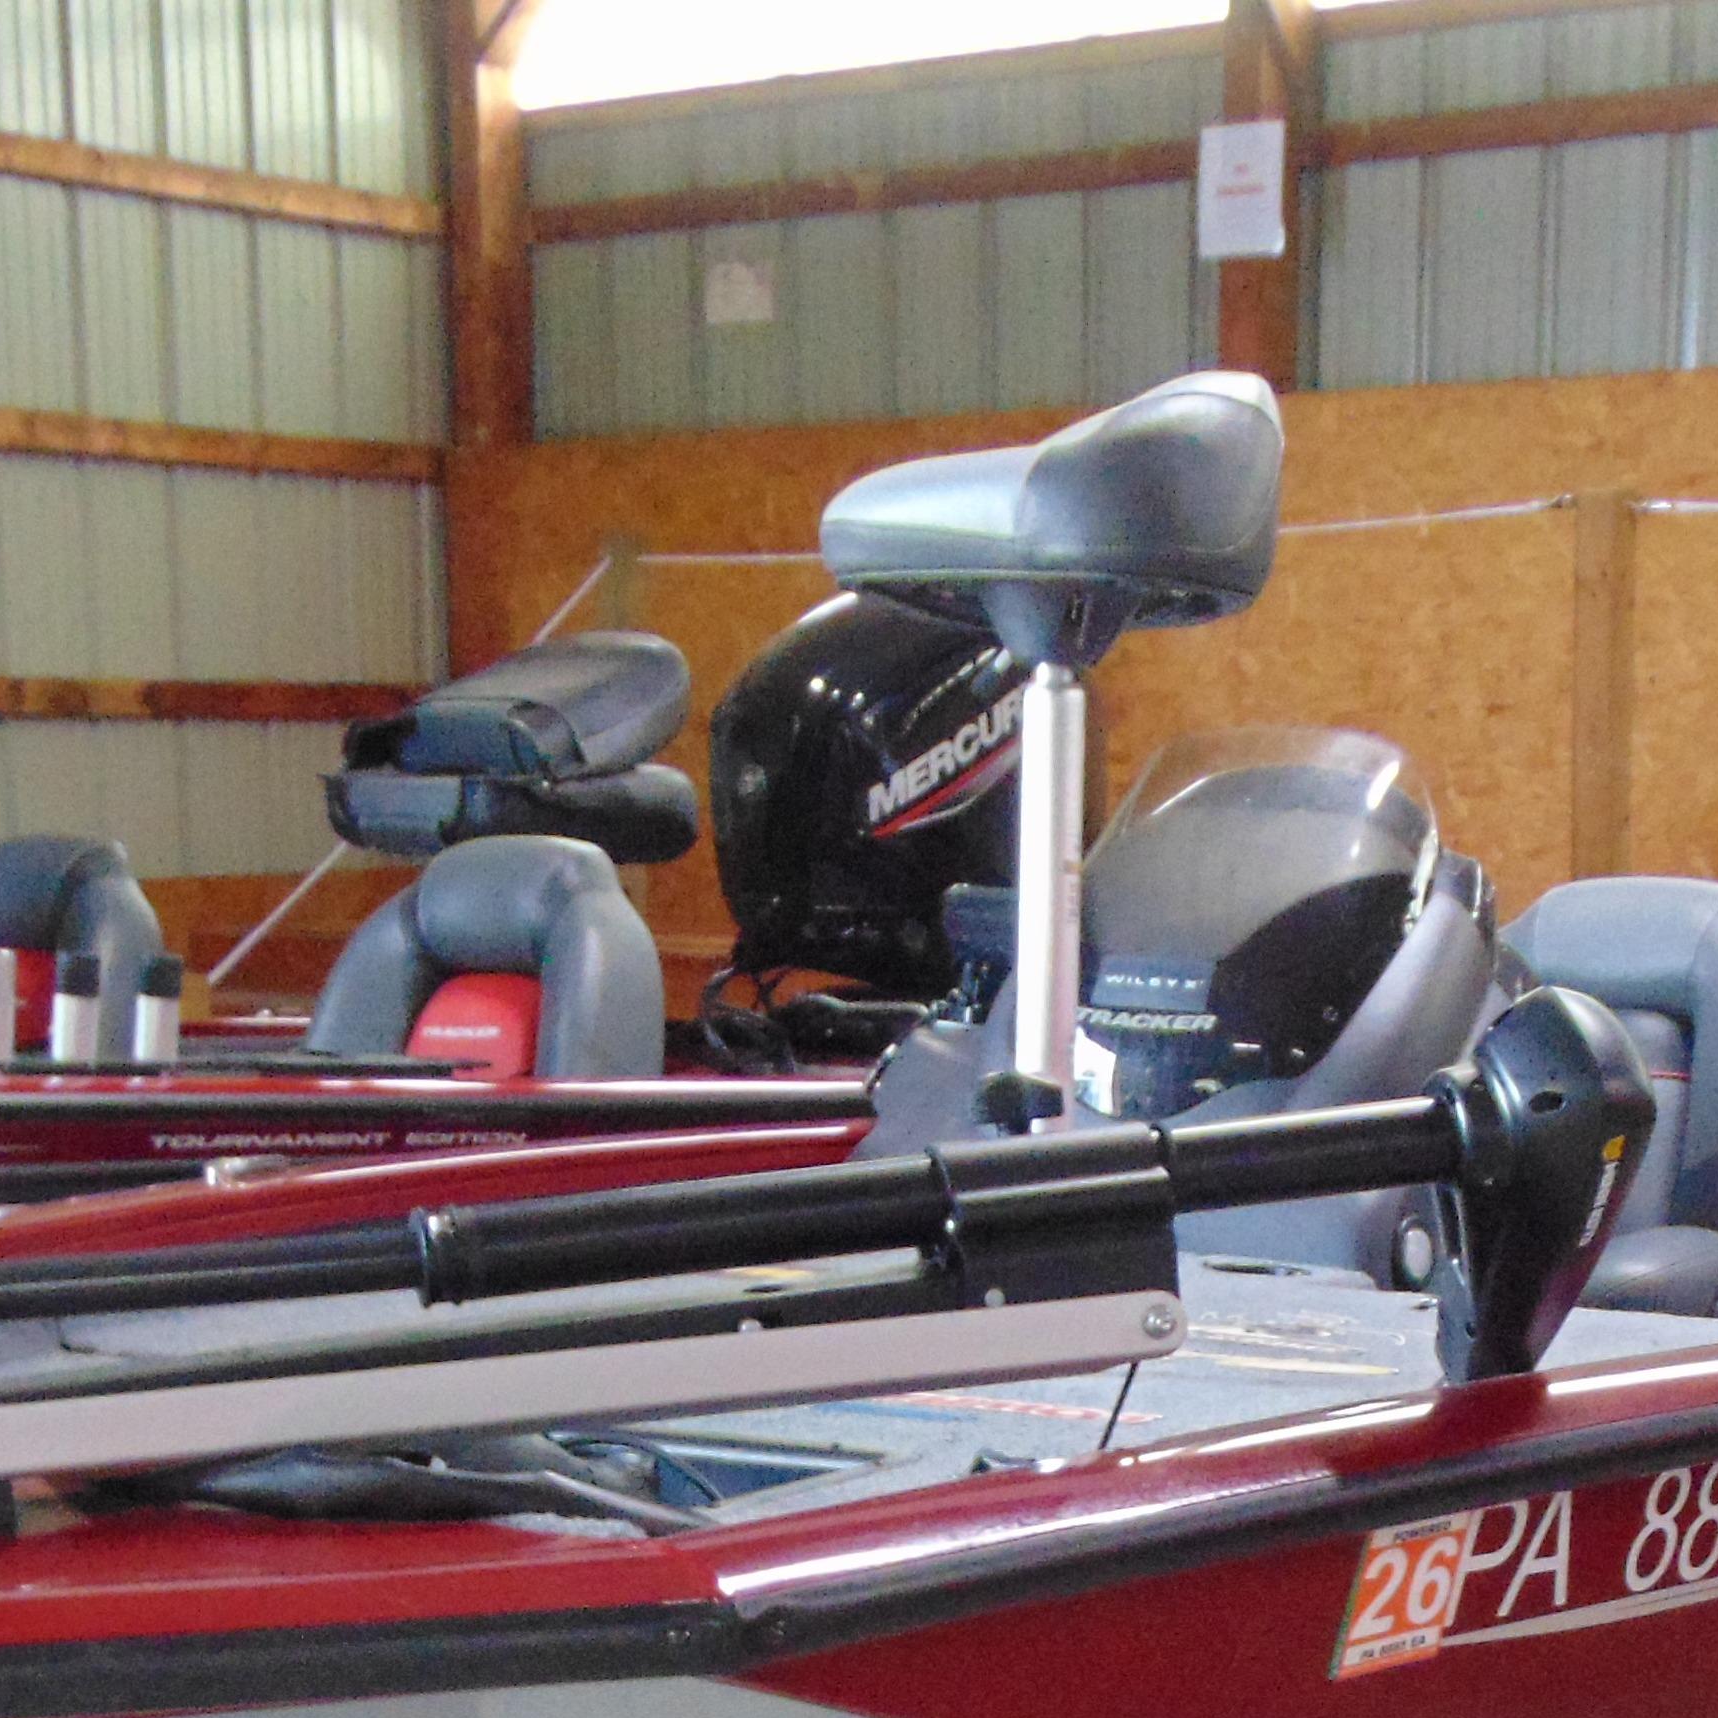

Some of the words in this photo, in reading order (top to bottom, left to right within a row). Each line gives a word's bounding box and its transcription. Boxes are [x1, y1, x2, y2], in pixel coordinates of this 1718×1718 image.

[152, 1131, 391, 1150] TOURNAMENT
[405, 1131, 527, 1147] EDITION
[1348, 1535, 1459, 1642] 26
[1444, 1491, 1573, 1628] PA
